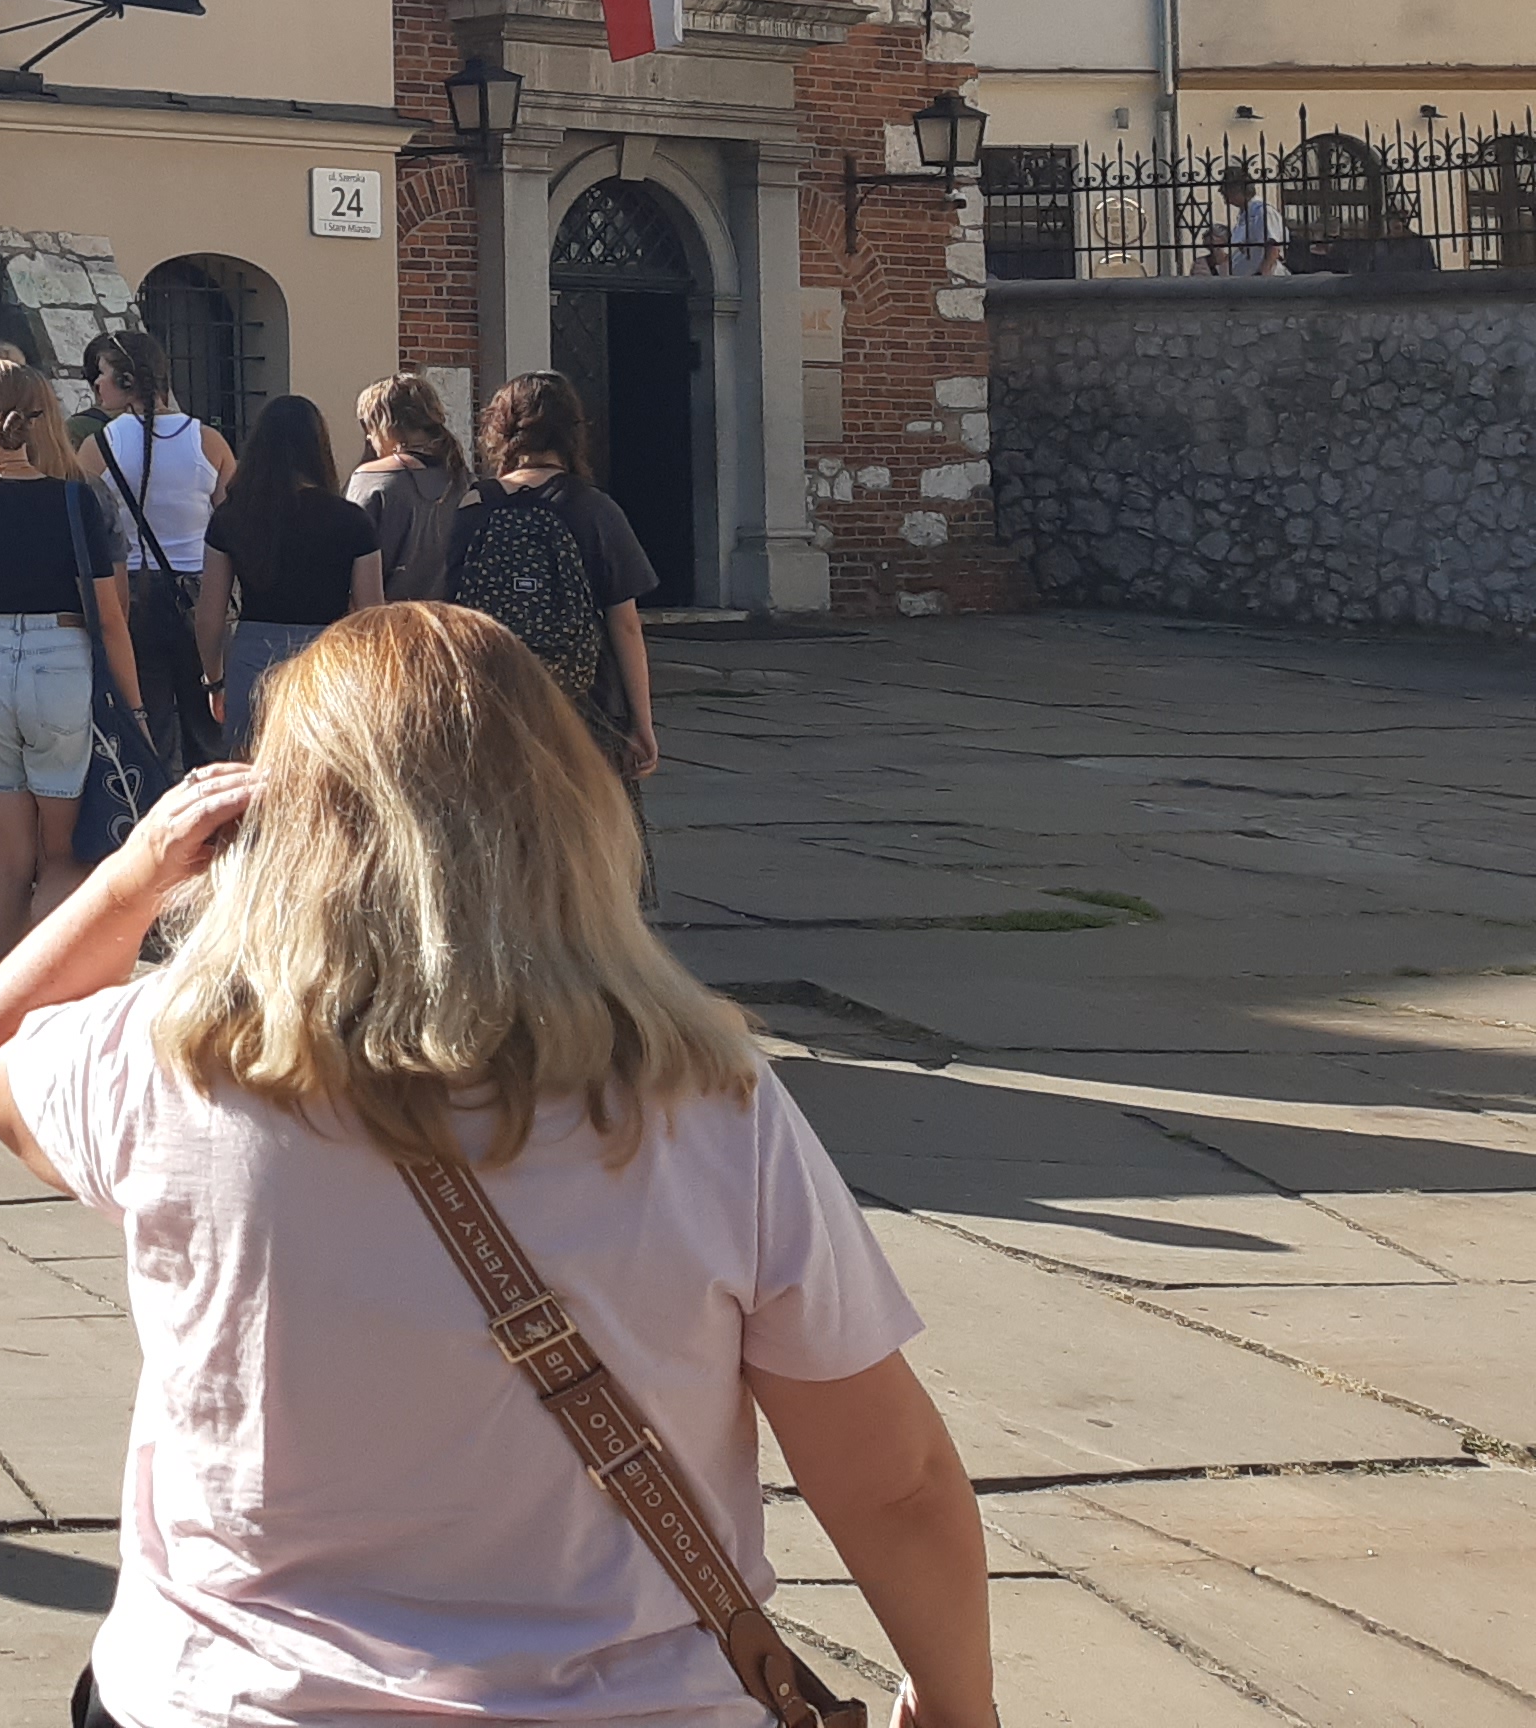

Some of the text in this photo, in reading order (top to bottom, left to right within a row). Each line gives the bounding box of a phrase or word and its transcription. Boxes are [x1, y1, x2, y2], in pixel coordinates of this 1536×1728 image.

[332, 186, 364, 218] 24
[329, 223, 346, 232] Stare
[348, 225, 372, 233] Miasto
[589, 1413, 625, 1455] OLO
[624, 1460, 737, 1617] HILLS POLO CLUB
